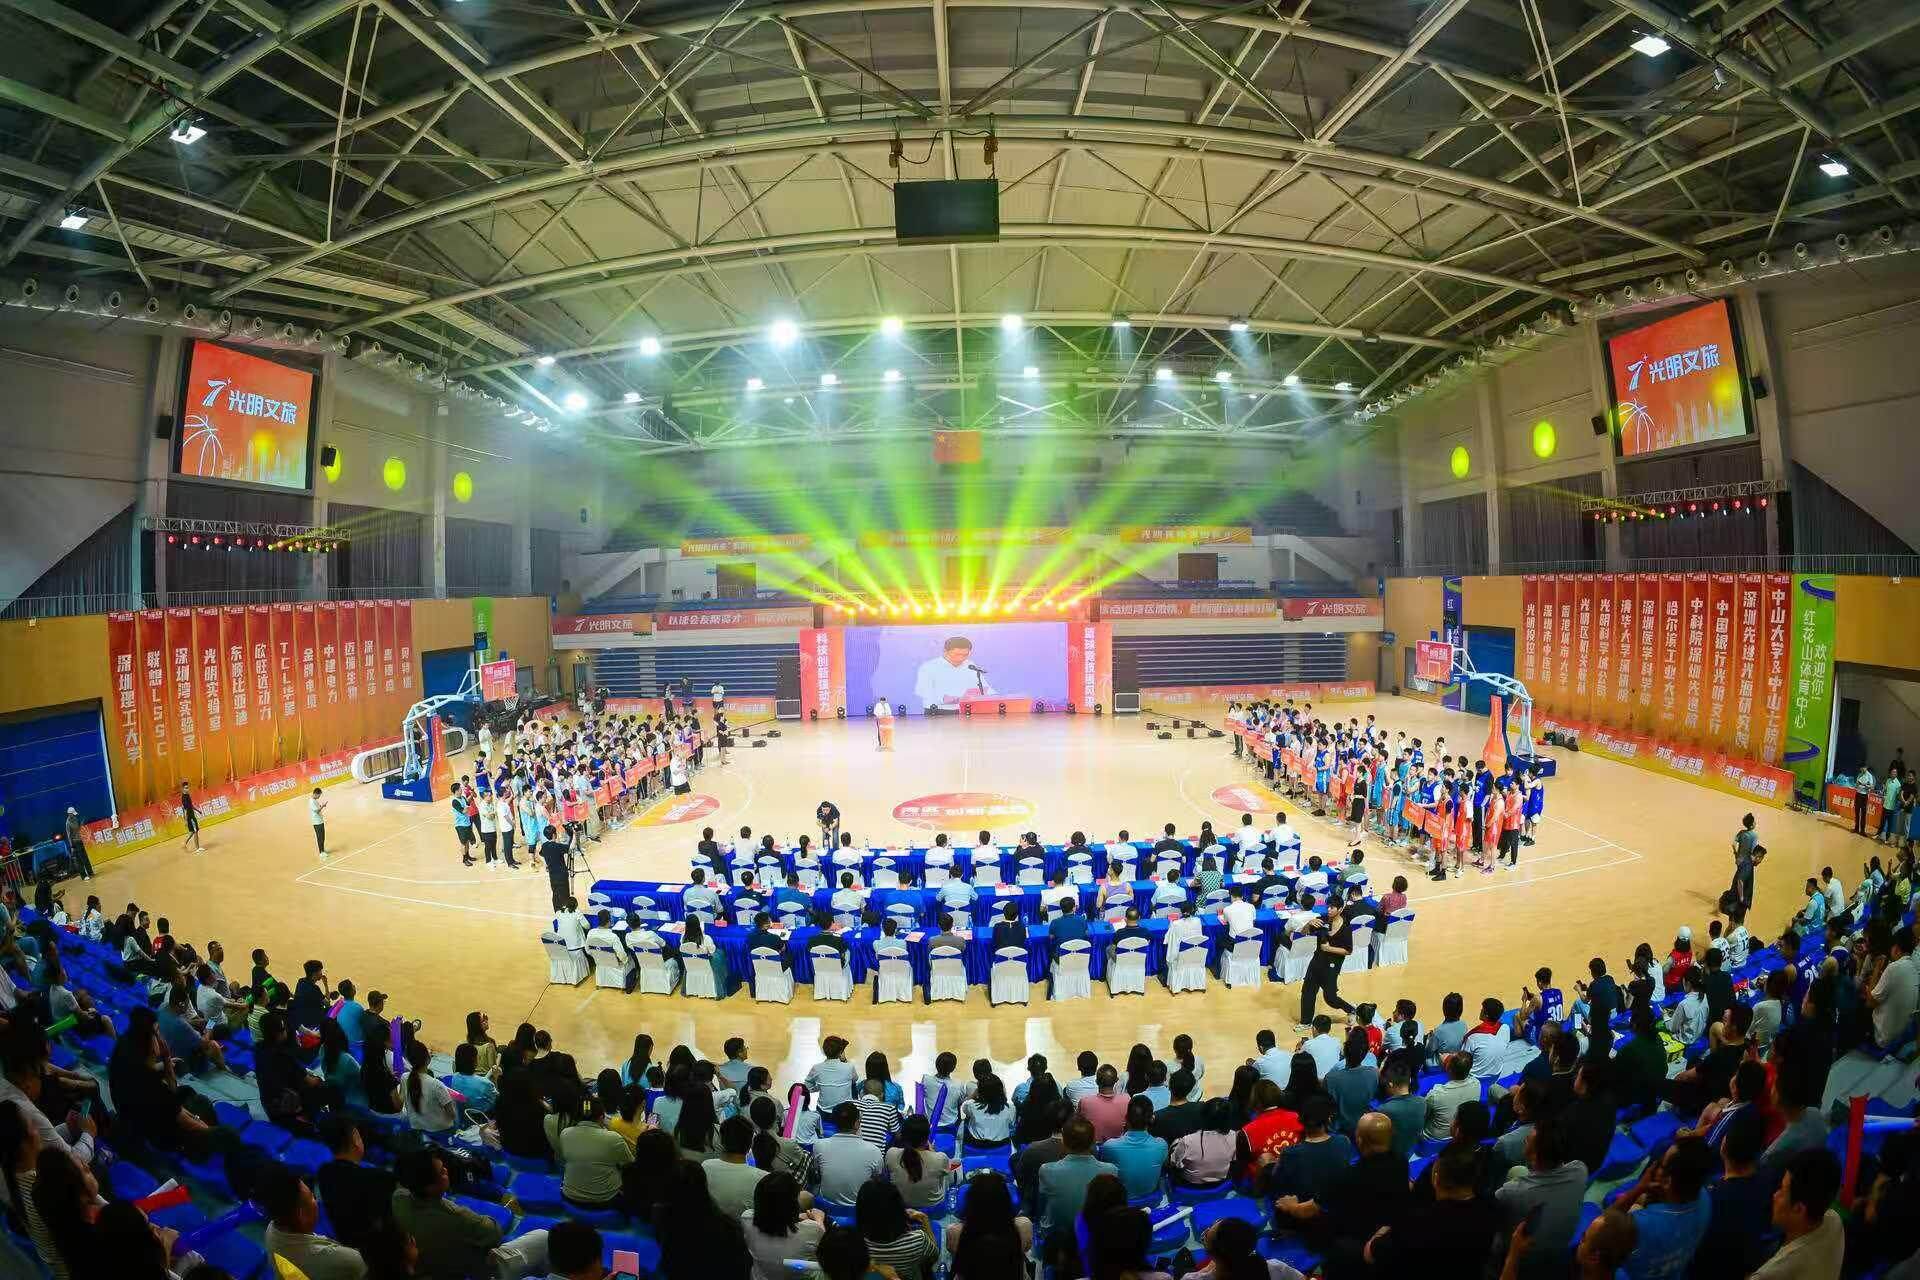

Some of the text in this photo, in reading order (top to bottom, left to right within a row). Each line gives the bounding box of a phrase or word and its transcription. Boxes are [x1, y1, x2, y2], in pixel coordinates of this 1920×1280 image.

[1649, 343, 1720, 383] 光明文旅
[228, 389, 298, 424] 光明文旅
[1793, 609, 1817, 729] 红花山体育中心
[117, 653, 143, 765] 深圳理工大学
[1547, 1003, 1563, 1022] 30
